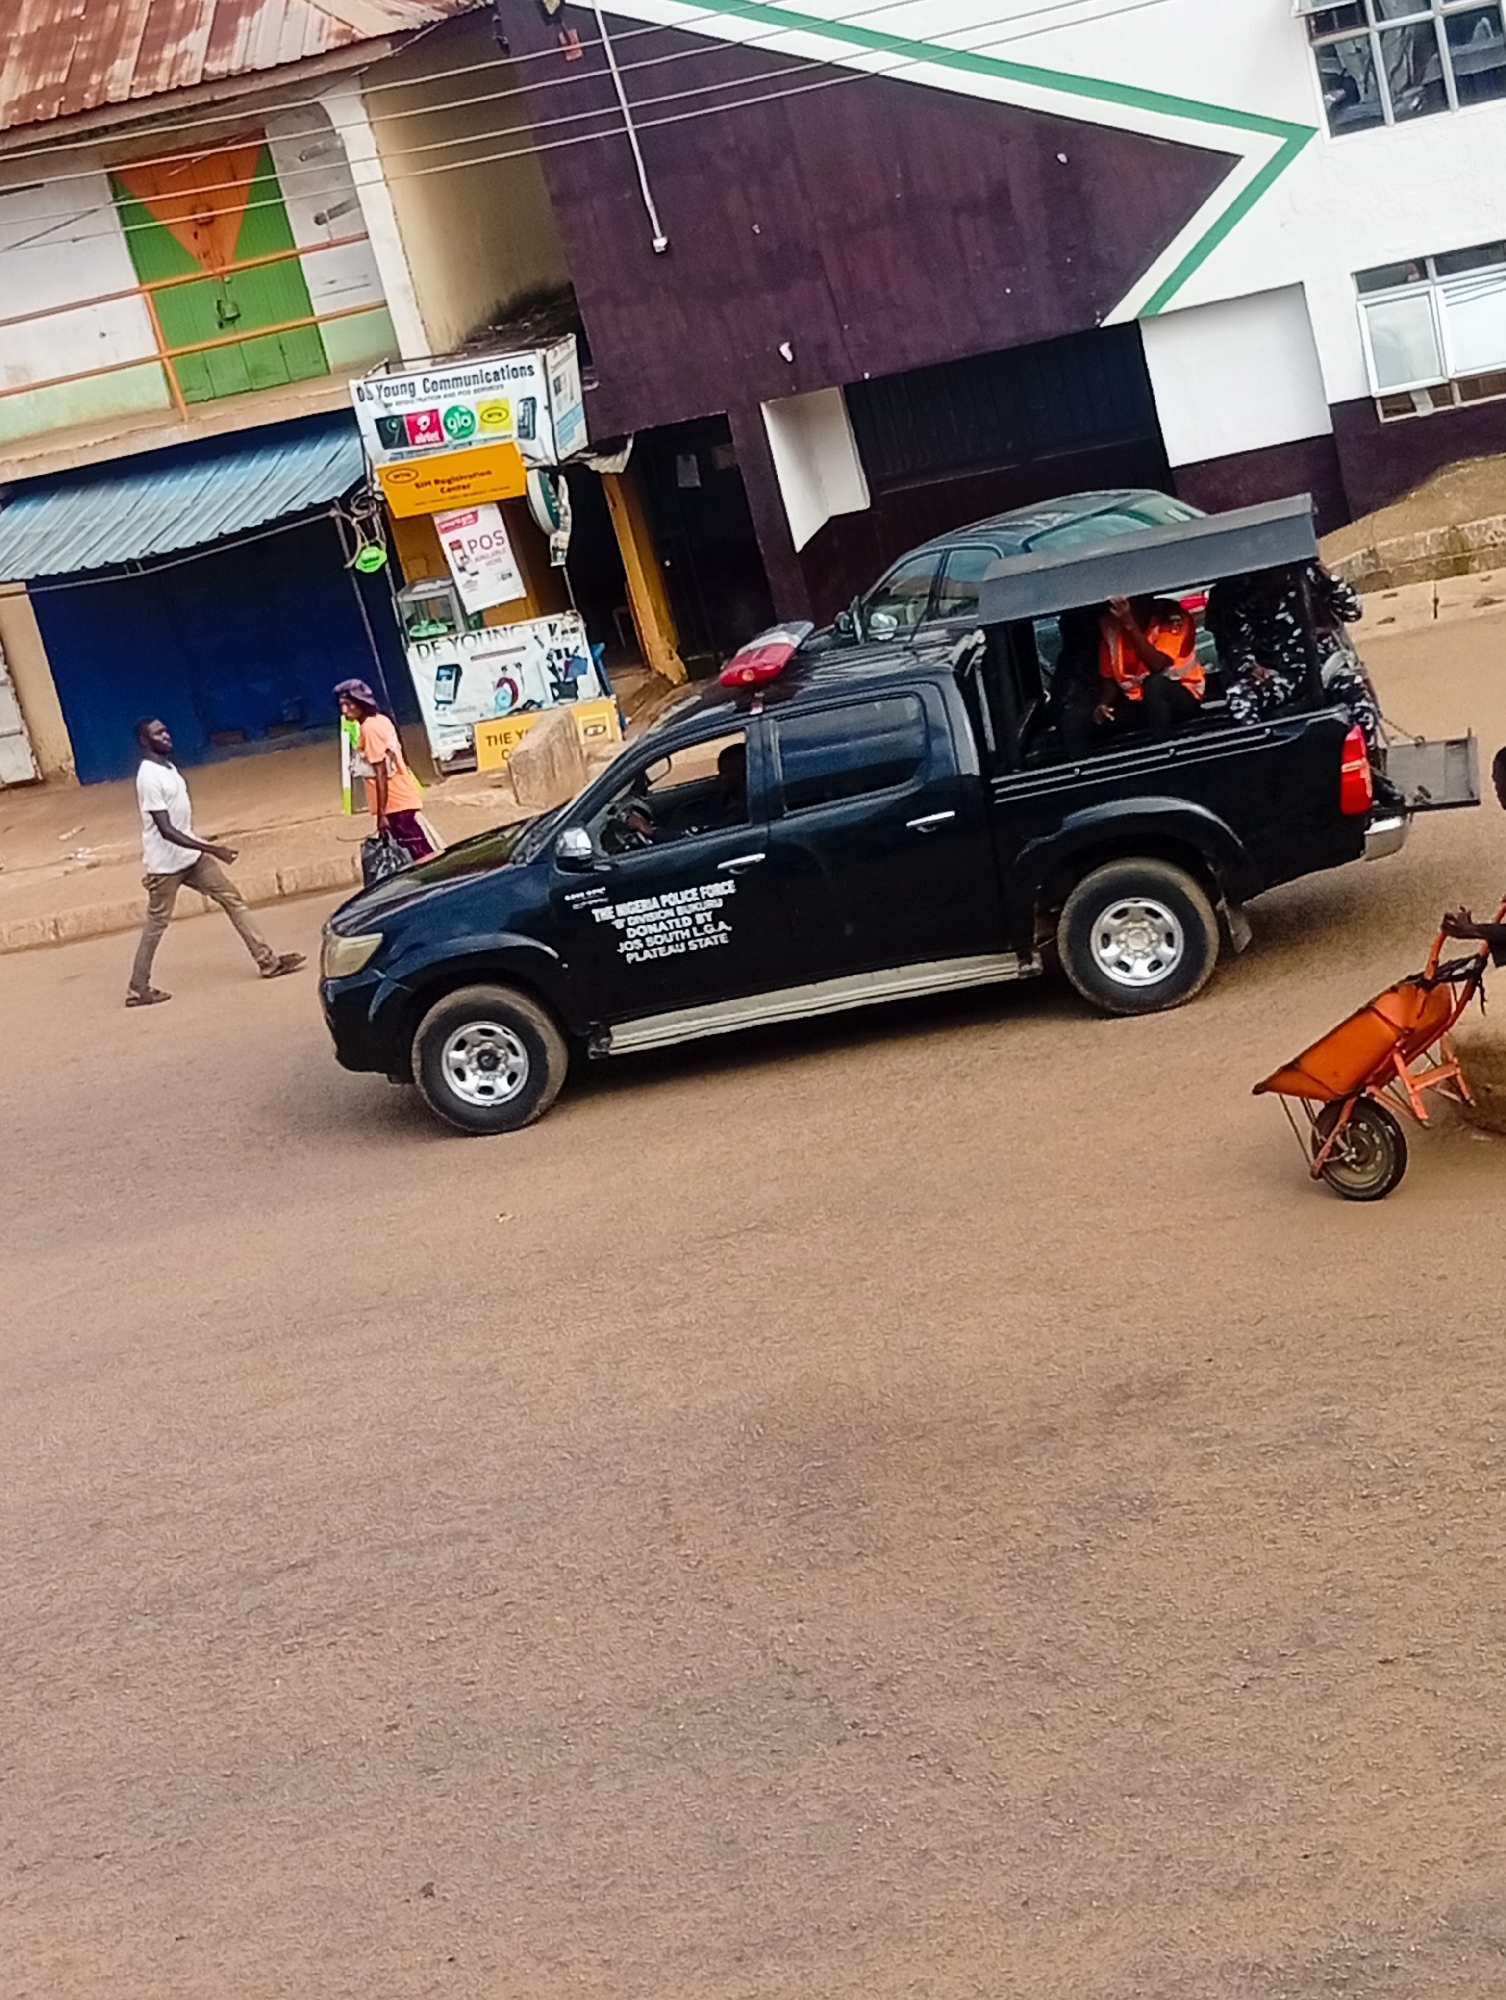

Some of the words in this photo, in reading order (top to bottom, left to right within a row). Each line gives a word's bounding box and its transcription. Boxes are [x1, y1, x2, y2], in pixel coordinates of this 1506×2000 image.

[376, 382, 416, 400] Young
[422, 364, 535, 394] Communications
[446, 412, 472, 434] glo
[414, 431, 441, 444] airtel
[415, 480, 432, 489] SIM
[434, 470, 492, 485] Registration
[440, 483, 472, 494] Center
[467, 530, 505, 554] POS
[485, 731, 513, 747] THE
[660, 887, 700, 908] POLICE
[700, 879, 737, 900] FORCE
[626, 916, 693, 939] DONATED
[695, 911, 713, 925] BY
[617, 940, 643, 954] JOS
[645, 930, 691, 947] SOUTH
[625, 943, 686, 964] PLATEAU
[687, 932, 730, 951] STATE
